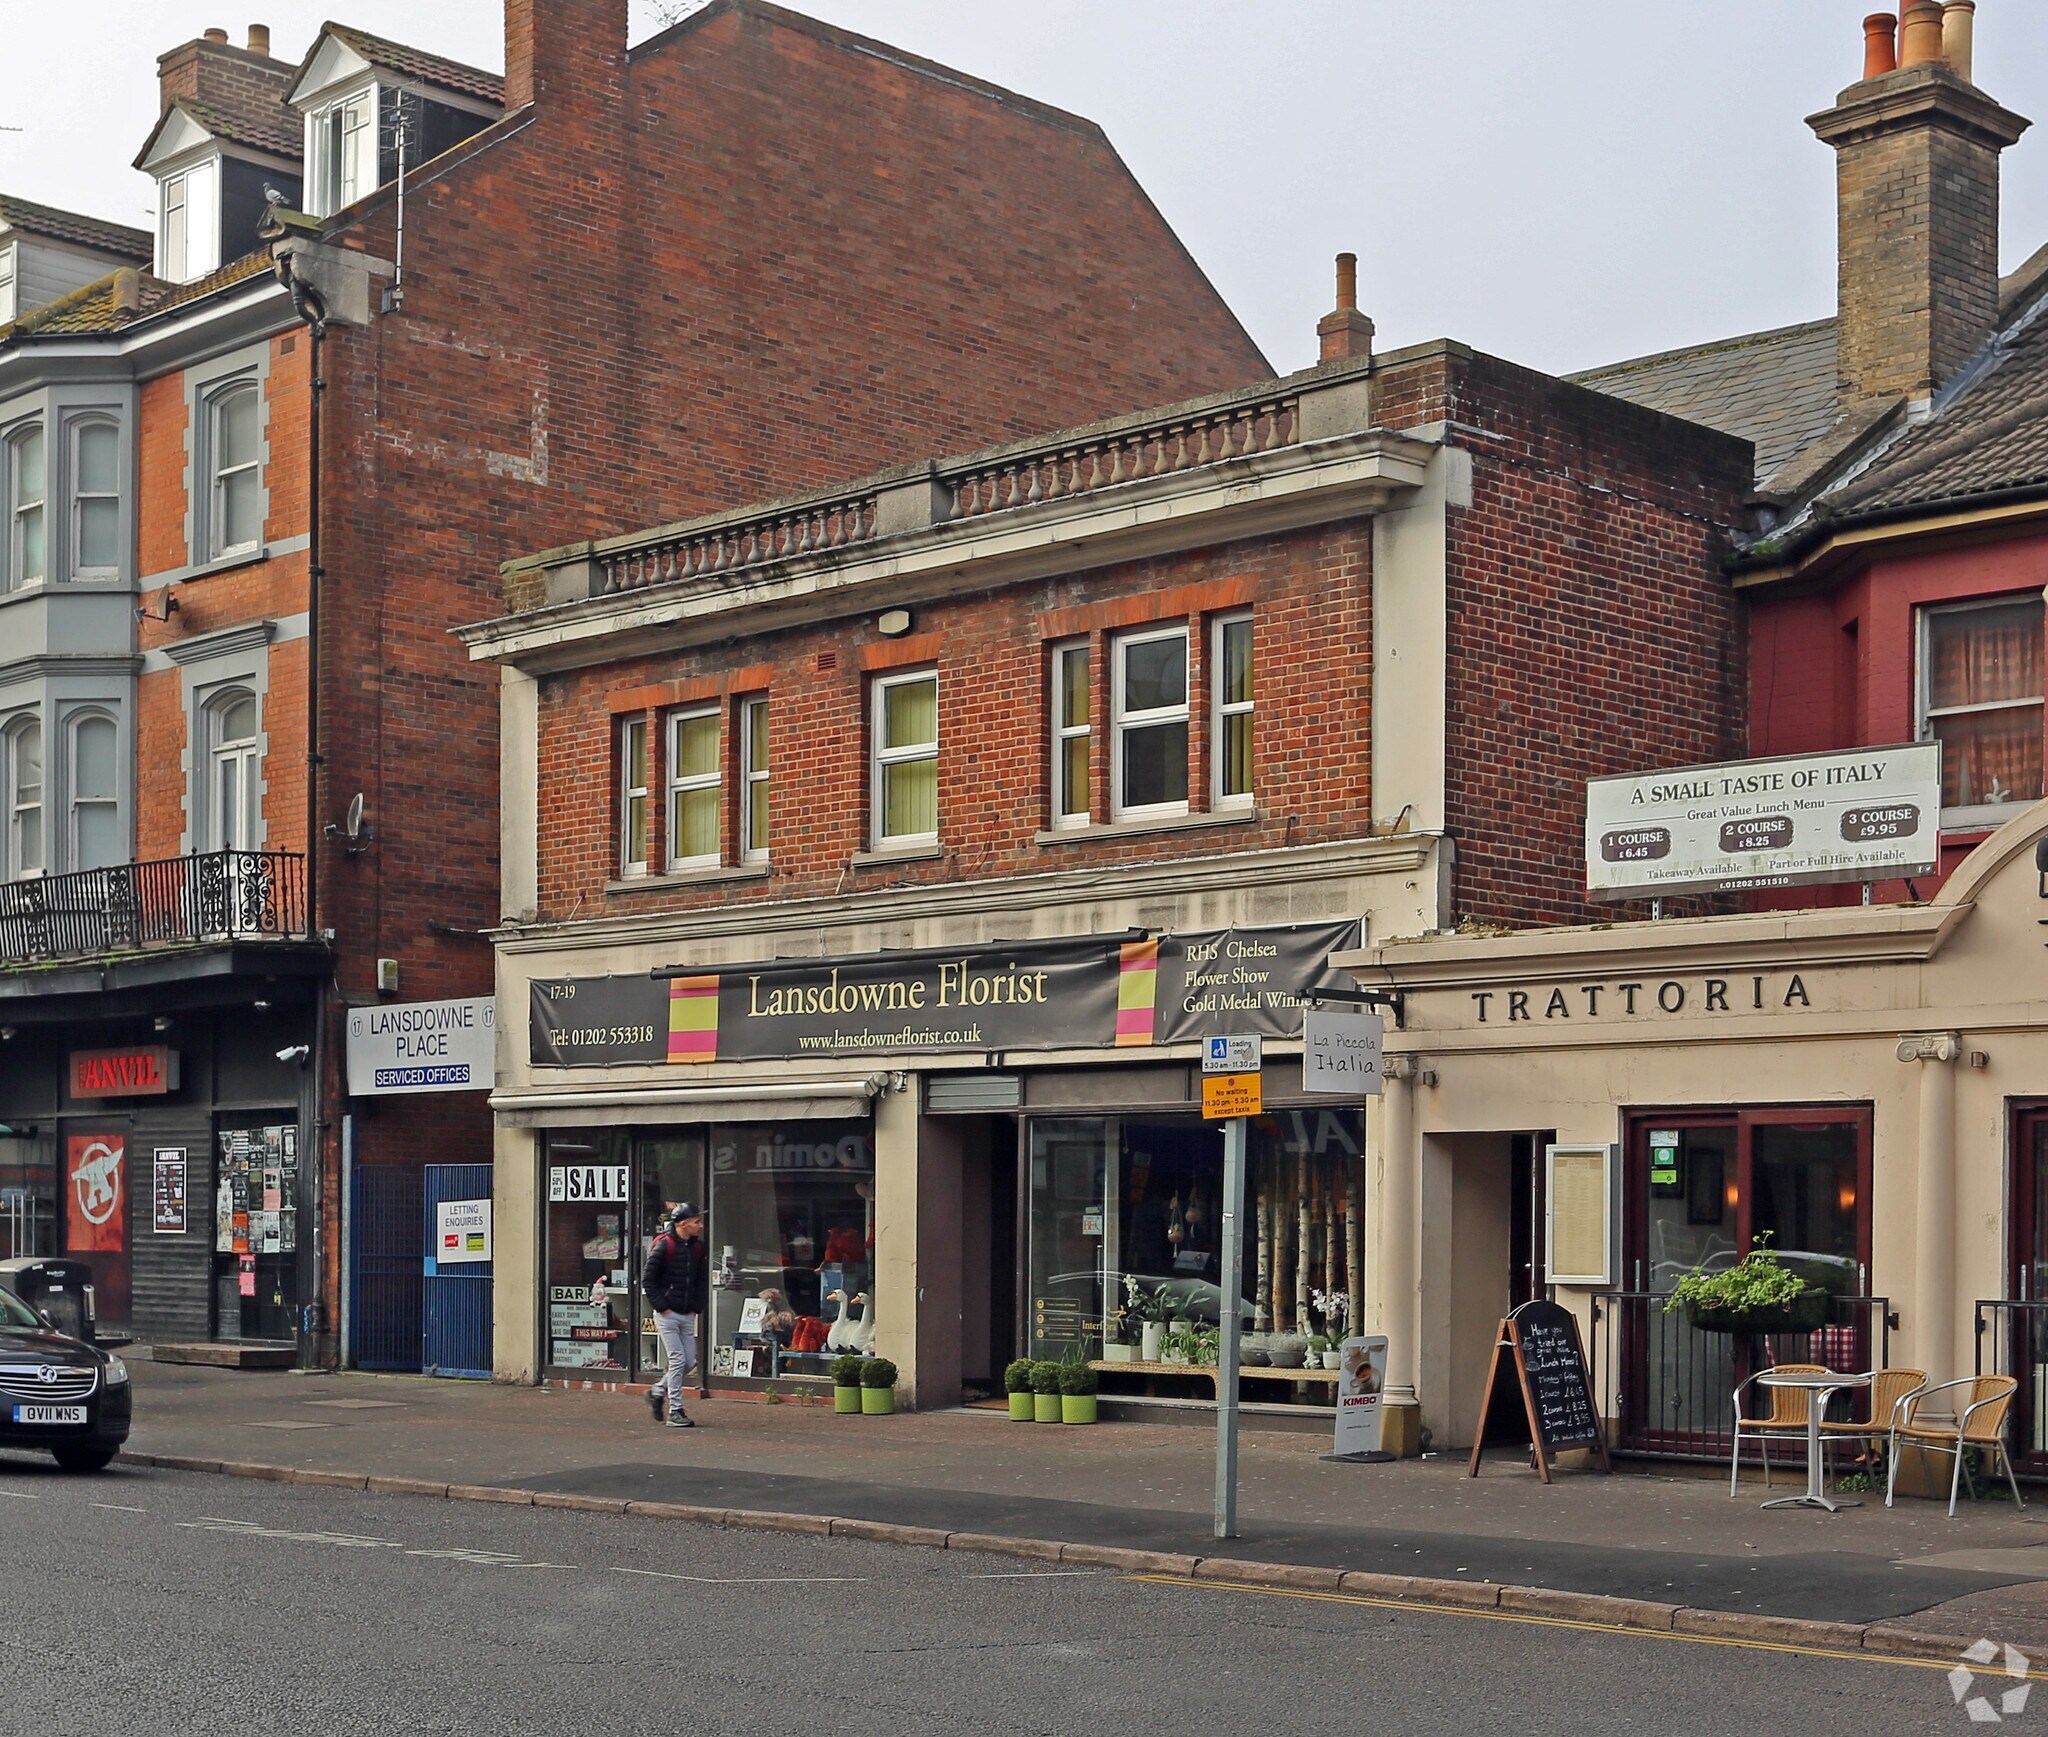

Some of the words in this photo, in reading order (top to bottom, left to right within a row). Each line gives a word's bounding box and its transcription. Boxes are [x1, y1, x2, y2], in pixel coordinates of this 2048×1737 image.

[1630, 788, 1645, 805] A
[1651, 780, 1715, 803] SMALL
[1720, 773, 1785, 796] TASTE
[1791, 770, 1819, 788] OF
[1826, 763, 1887, 785] ITALY
[1687, 809, 1718, 820] Great
[1721, 804, 1752, 818] Value
[1756, 801, 1790, 814] Lunch
[1793, 799, 1825, 811] Menu
[1848, 814, 1858, 824] 3
[1861, 809, 1913, 824] COURSE
[1725, 825, 1734, 836] 2
[1737, 820, 1786, 835] COURSE
[1860, 823, 1898, 836] £9.95
[1608, 836, 1614, 846] 1
[1618, 832, 1664, 846] COURSE
[1768, 860, 1790, 870] Part
[1793, 859, 1805, 868] or
[1807, 855, 1828, 866] Full
[1830, 853, 1854, 865] Hire
[1856, 850, 1905, 863] Available
[1647, 867, 1695, 879] Takeaway
[1696, 863, 1743, 876] Available
[1755, 876, 1789, 887] 551510
[1185, 943, 1219, 962] RHS
[1226, 939, 1278, 959] Chelsea
[1184, 970, 1229, 988] Flower
[1231, 966, 1270, 984] Show
[549, 985, 577, 1000] 17-19
[747, 967, 926, 1018] Lansdowne
[935, 959, 1048, 1008] Florist
[1183, 993, 1217, 1013] Gold
[1219, 991, 1262, 1011] Medal
[1471, 974, 1810, 1022] TRATTORIA
[370, 1006, 474, 1035] LANSDOWNE
[484, 1010, 493, 1023] 17
[352, 1020, 361, 1030] 17
[550, 1029, 569, 1047] Tel:
[571, 1028, 607, 1046] 01202
[608, 1025, 654, 1045] 553318
[798, 1021, 983, 1050] www.lansdowneflorist.co.uk
[1313, 1033, 1330, 1047] La
[1335, 1033, 1376, 1050] Piccola
[396, 1034, 448, 1058] PLACE
[1228, 1040, 1252, 1048] Loading
[1232, 1060, 1249, 1068] 11.30
[1314, 1053, 1376, 1073] Italia
[84, 1055, 160, 1088] ANVIL
[376, 1069, 425, 1085] SERVICED
[426, 1066, 470, 1083] OFFICES
[1226, 1087, 1248, 1095] waiting
[1205, 1099, 1221, 1107] 11.30
[1234, 1096, 1249, 1104] 5.30
[1214, 1108, 1234, 1116] except
[569, 1168, 627, 1198] SALE
[449, 1204, 479, 1215] LETTING
[445, 1215, 484, 1227] ENQUIRIES
[555, 1288, 585, 1300] BAR
[575, 1329, 590, 1337] THIS
[1343, 1396, 1377, 1407] KIMBO
